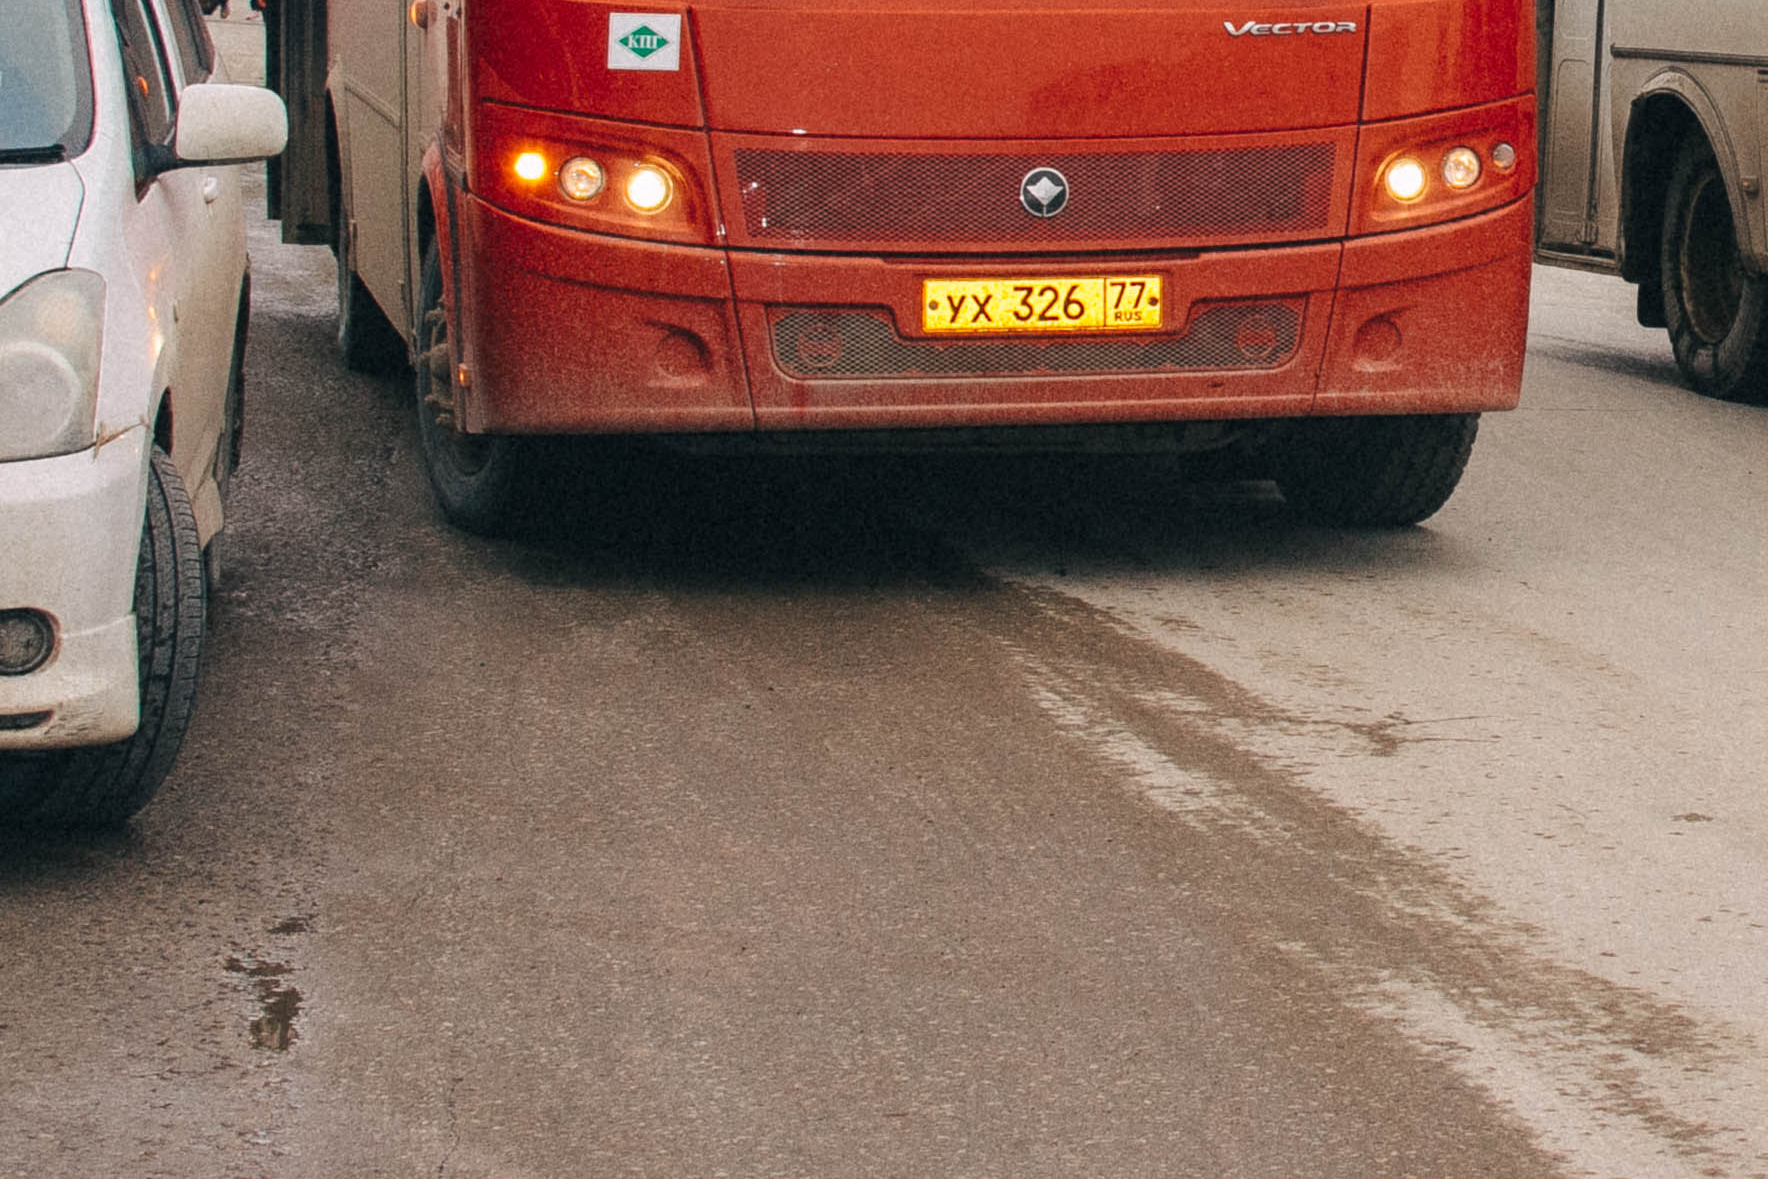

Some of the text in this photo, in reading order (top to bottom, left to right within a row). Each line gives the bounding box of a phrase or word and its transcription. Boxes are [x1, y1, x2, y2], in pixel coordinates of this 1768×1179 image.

[627, 34, 664, 50] КПГ
[946, 281, 1146, 324] УХ 326 77
[1114, 310, 1143, 322] RUS
